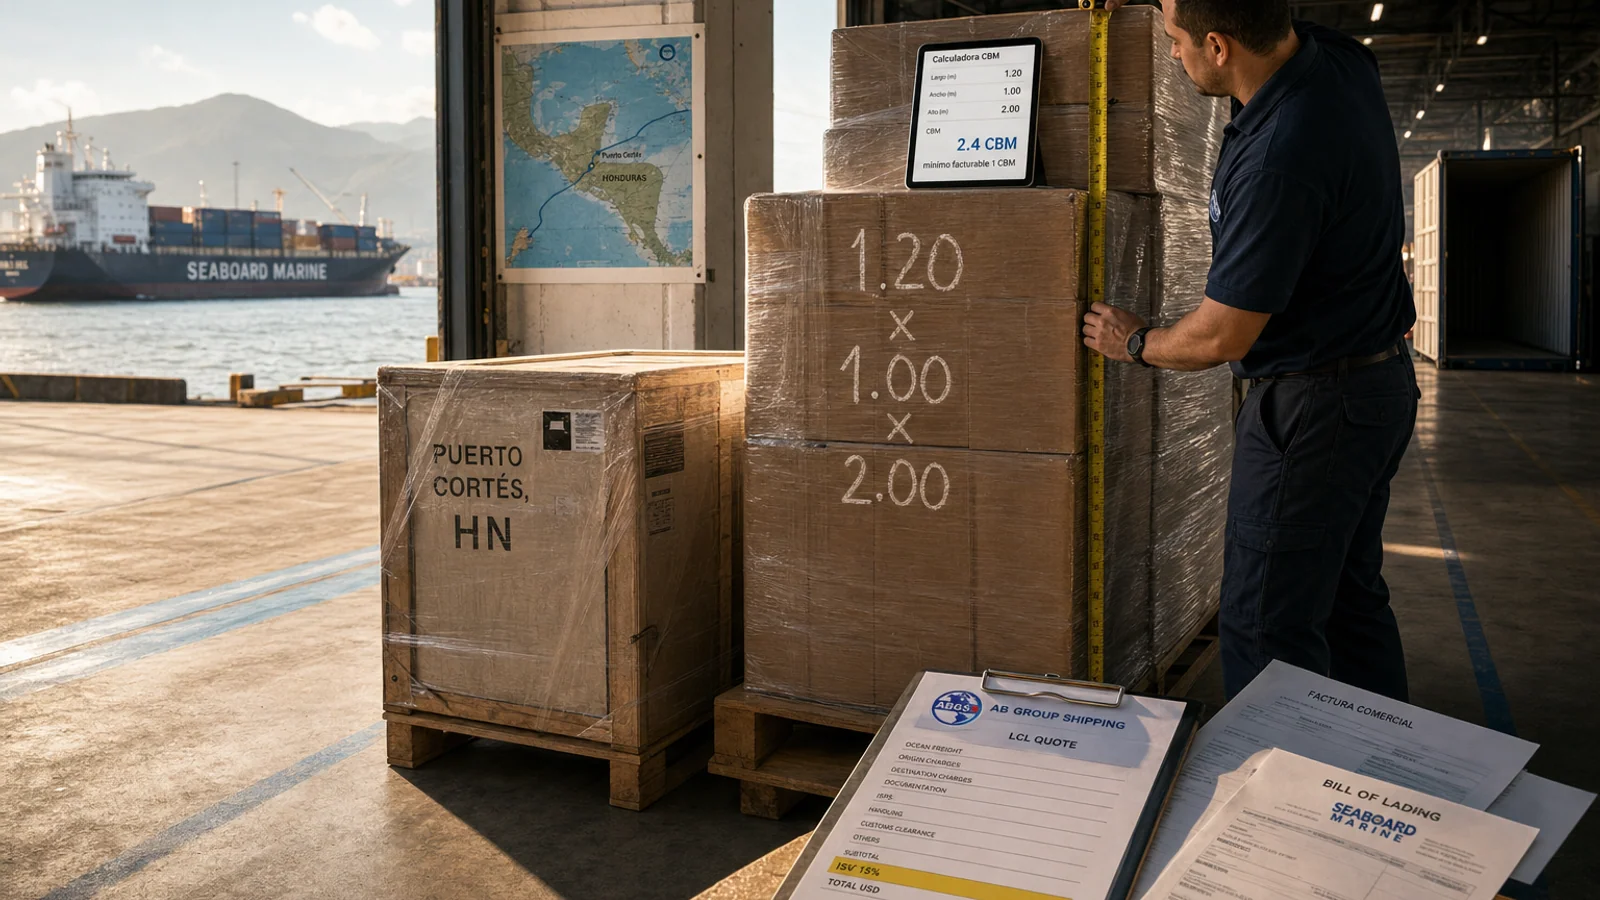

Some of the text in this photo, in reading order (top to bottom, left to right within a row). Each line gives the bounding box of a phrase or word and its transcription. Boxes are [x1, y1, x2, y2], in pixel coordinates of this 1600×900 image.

[932, 52, 1000, 63] Calculadora CBM
[1004, 69, 1022, 78] 1.20
[1004, 87, 1021, 95] 1.00
[1001, 105, 1020, 114] 2.00
[957, 137, 1017, 151] 2.4 CBM
[952, 160, 990, 168] facturable
[998, 159, 1016, 167] CBM
[851, 228, 964, 292] 1.20
[187, 261, 327, 280] SEABOARD MARINE
[840, 345, 951, 404] 1.00
[433, 444, 522, 467] PUERTO
[433, 473, 529, 503] CORTÉS,
[842, 455, 949, 510] 2.00
[455, 514, 511, 551] HN
[935, 701, 970, 712] ABGS
[1308, 690, 1354, 711] FACTURA
[1356, 705, 1414, 729] COMERCIAL
[990, 704, 1126, 730] AB GROUP SHIPPING
[905, 741, 963, 754] OCEAN FREIGHT
[1008, 732, 1078, 750] LCL QUOTE
[891, 766, 972, 783] DESTINATION CHARGES
[884, 779, 948, 793] DOCUMENTATION
[1322, 779, 1441, 822] BILL OF LADING
[868, 807, 904, 817] HANDLING
[1332, 802, 1417, 836] SEABOARD
[860, 820, 936, 838] CUSTOMS CLEARANCE
[1330, 813, 1404, 843] MARINE
[853, 834, 880, 844] OTHERS
[843, 849, 880, 861] SUBTOTAL
[836, 862, 880, 876] ISV 15%
[828, 878, 880, 894] TOTAL USD
